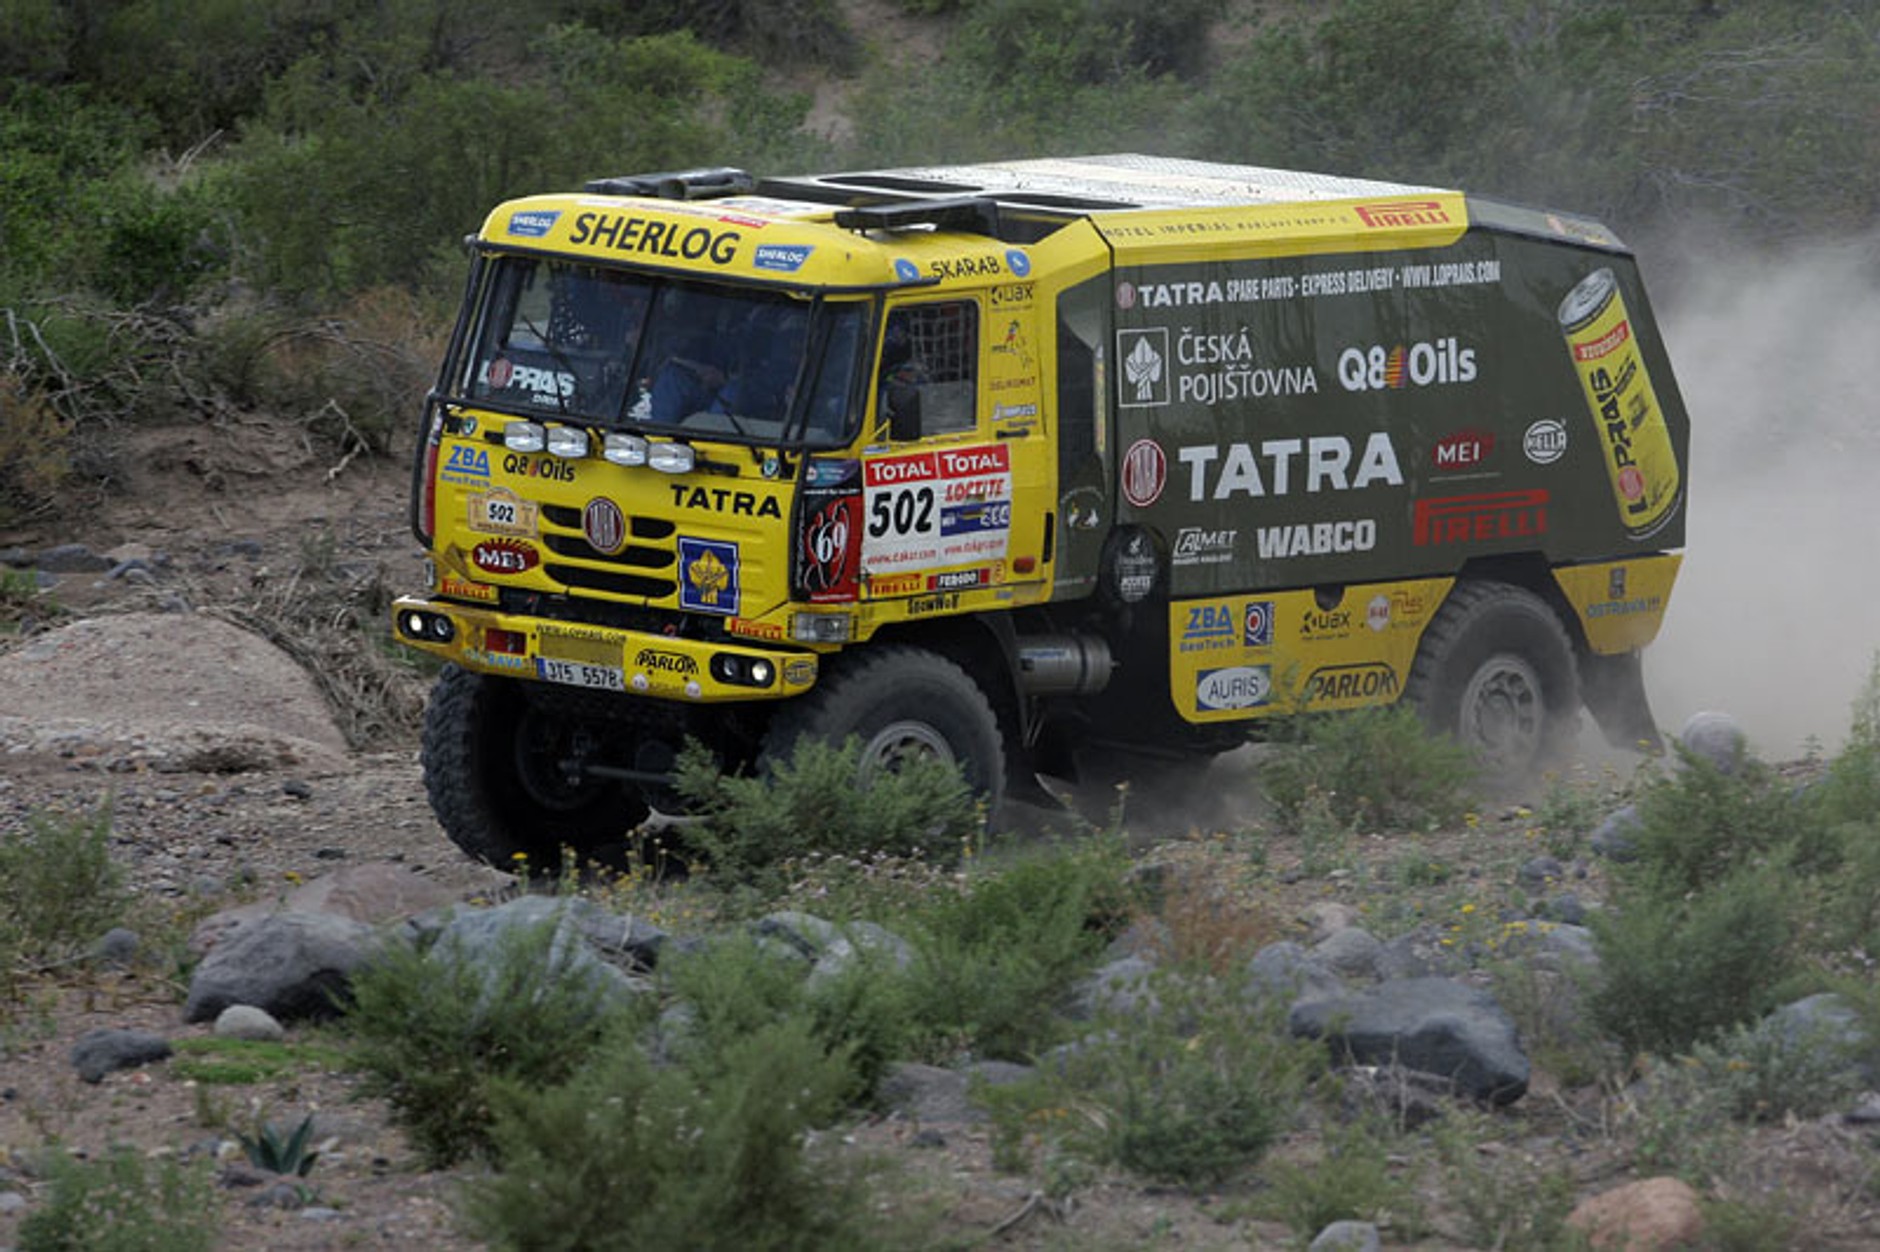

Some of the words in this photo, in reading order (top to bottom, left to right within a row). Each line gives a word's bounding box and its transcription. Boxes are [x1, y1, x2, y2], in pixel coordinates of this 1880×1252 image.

[1354, 202, 1450, 227] PIRELLI
[569, 213, 741, 265] SHERLOG
[931, 256, 1000, 279] SKARAB
[1138, 281, 1224, 307] TATRA
[1227, 279, 1259, 301] SPARE
[1262, 277, 1294, 299] PARTS
[1302, 272, 1345, 296] EXPRESS
[1177, 326, 1253, 366] ČESKÁ
[1338, 345, 1388, 392] Q8
[1408, 337, 1478, 386] Oils
[448, 446, 490, 474] ZBA
[942, 453, 1003, 473] TOTAL
[1179, 432, 1404, 501] TATRA
[1437, 441, 1480, 464] MEI
[503, 454, 528, 476] Q8
[541, 458, 575, 482] Oils
[870, 461, 931, 481] TOTAL
[489, 502, 514, 522] 502
[671, 484, 782, 519] TATRA
[868, 487, 934, 538] 502
[1413, 489, 1550, 547] PIRELLI
[1257, 518, 1376, 560] WABCO
[1187, 604, 1232, 630] ZBA
[1208, 676, 1260, 701] AURIS
